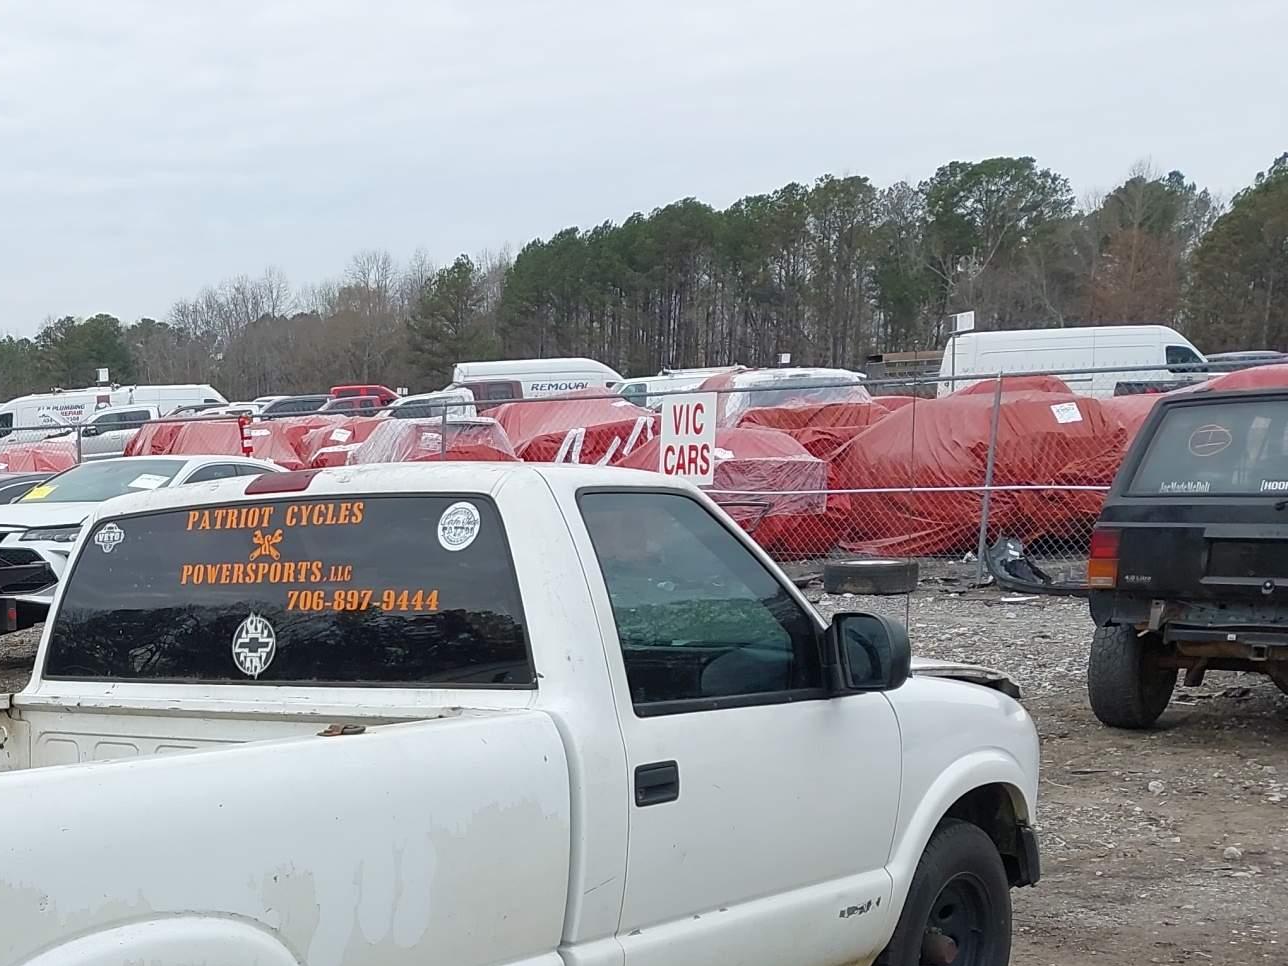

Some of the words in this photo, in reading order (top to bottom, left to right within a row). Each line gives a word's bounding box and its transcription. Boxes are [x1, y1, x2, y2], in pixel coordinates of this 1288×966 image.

[673, 403, 704, 435] VIC
[664, 444, 710, 475] CARS
[186, 506, 274, 530] PATRIOT
[285, 502, 364, 527] CYCLES
[329, 565, 353, 582] LLC
[287, 590, 439, 611] 706-897-9444
